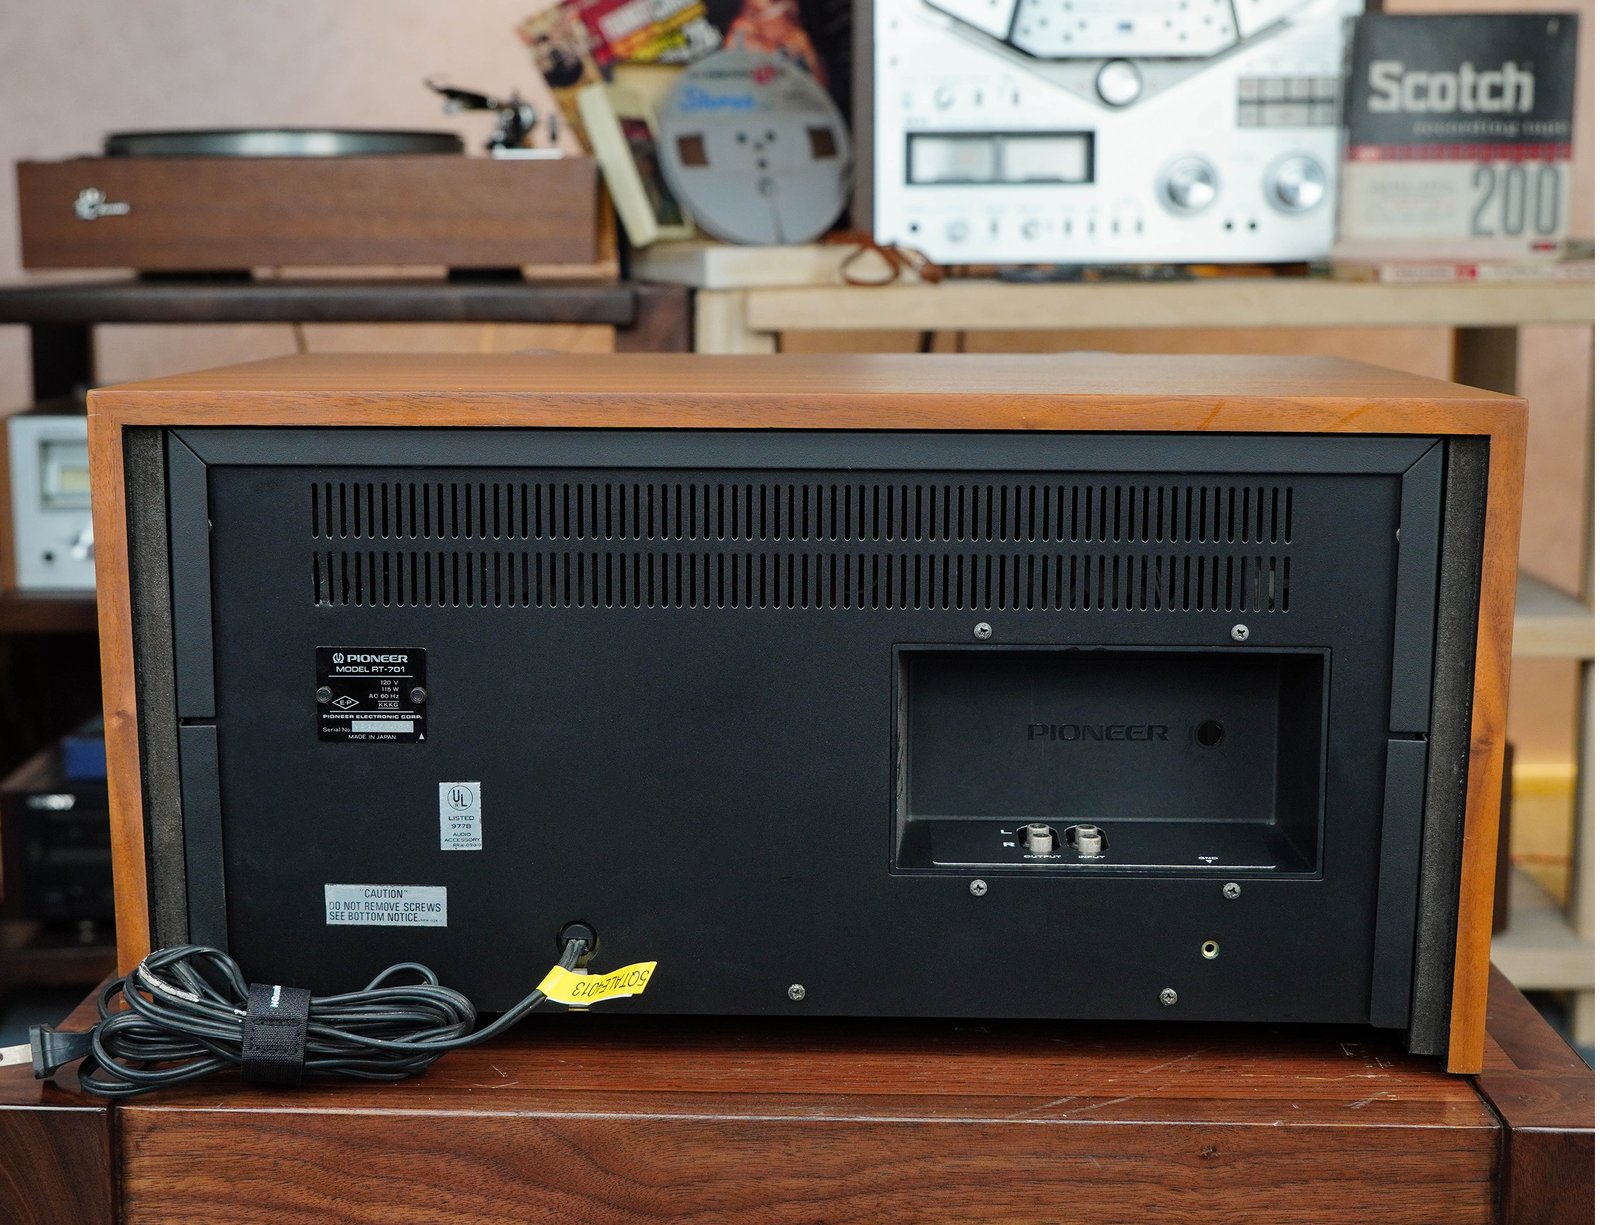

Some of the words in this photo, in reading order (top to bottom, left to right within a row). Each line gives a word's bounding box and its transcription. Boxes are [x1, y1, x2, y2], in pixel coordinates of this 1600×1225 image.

[1367, 60, 1535, 113] Scotch
[1470, 162, 1562, 237] 200
[347, 654, 409, 663] PIONEER
[1027, 723, 1170, 742] PIONEER
[452, 789, 468, 807] UL
[329, 902, 341, 911] DO
[343, 902, 361, 911] NOT
[364, 903, 400, 912] REMOVE
[403, 903, 442, 912] SCREWS
[329, 911, 345, 920] SEE
[348, 912, 385, 921] BOTTOM
